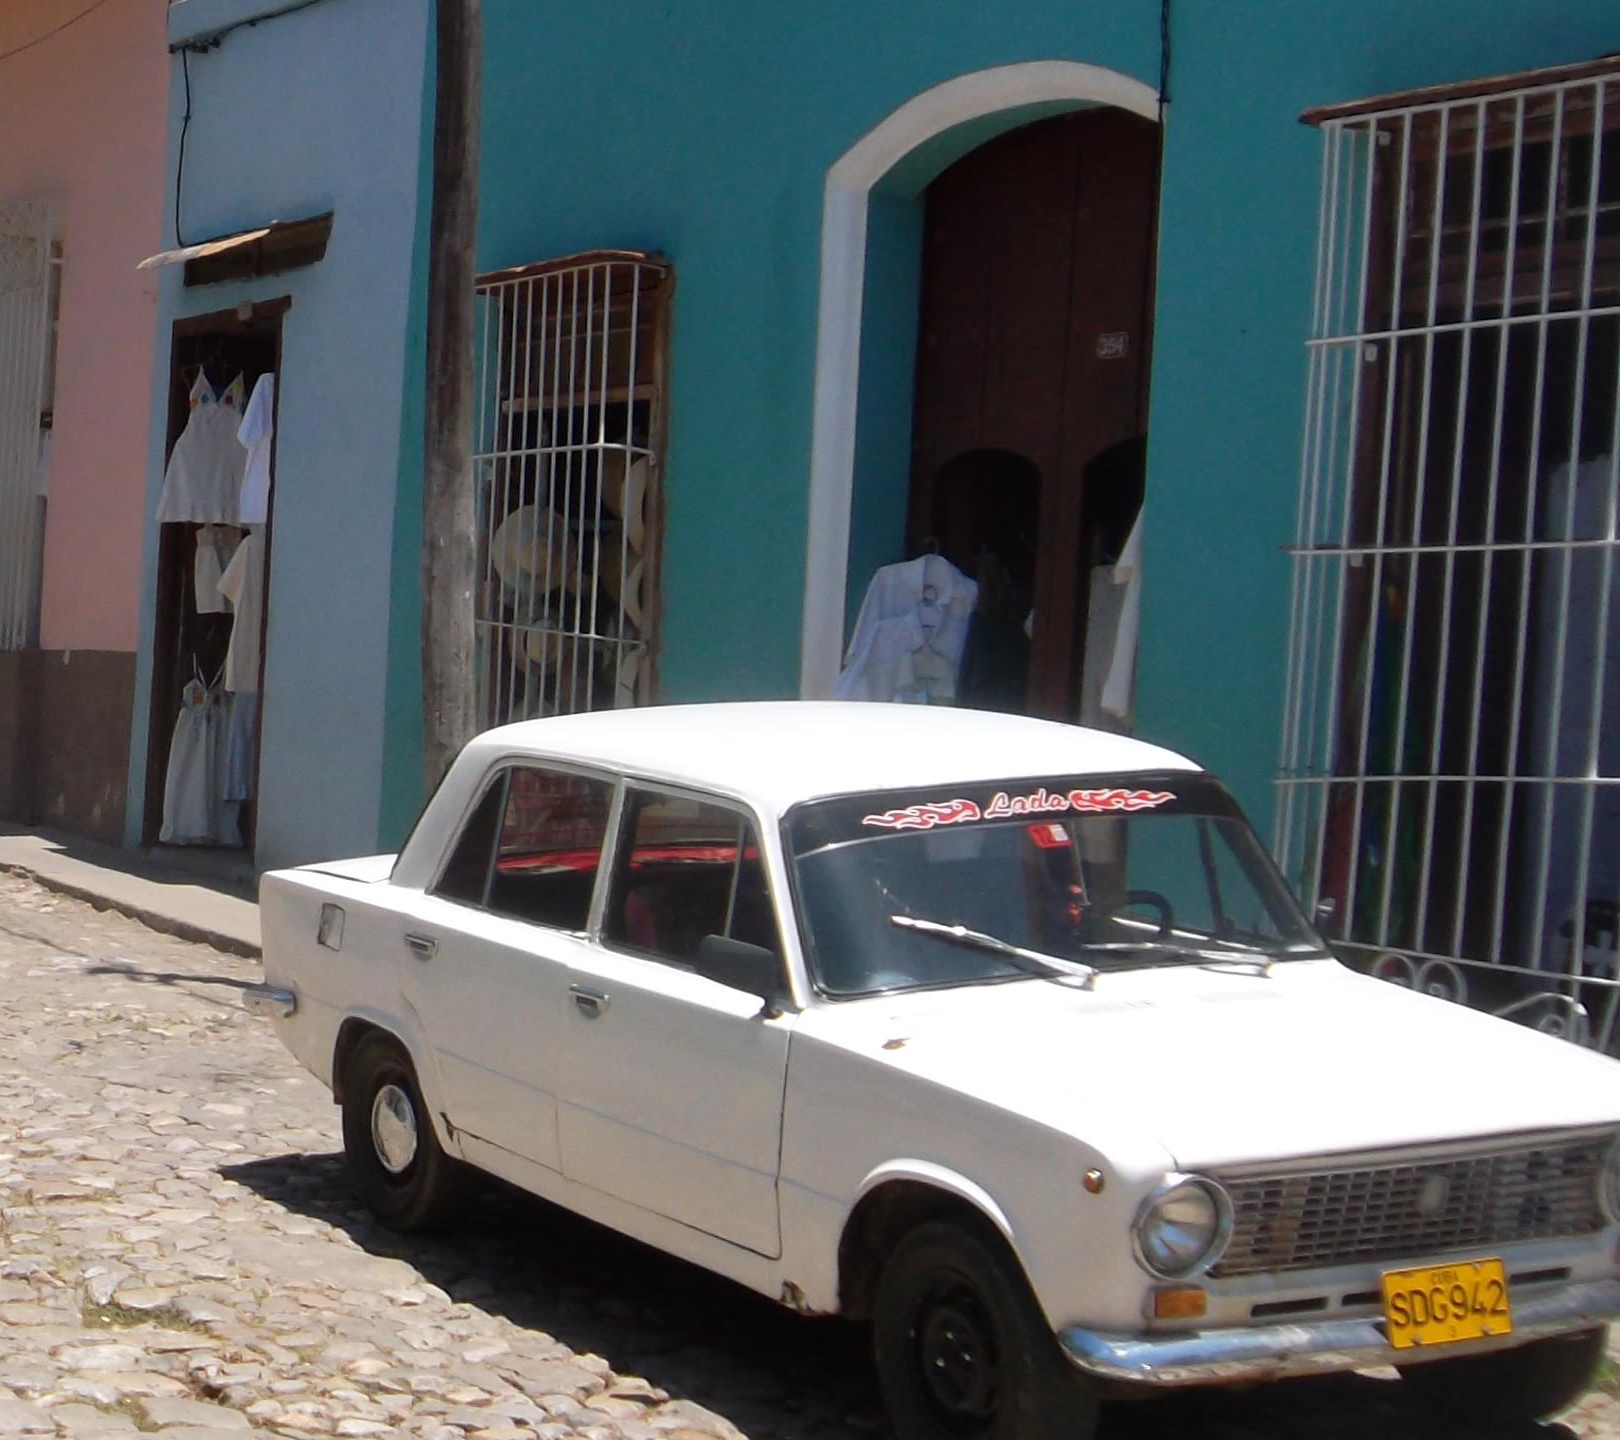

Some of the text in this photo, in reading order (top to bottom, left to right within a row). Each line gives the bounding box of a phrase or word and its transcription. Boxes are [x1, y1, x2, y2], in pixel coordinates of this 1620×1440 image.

[984, 788, 1070, 818] Lada
[1430, 1270, 1460, 1284] CUBA
[1390, 1279, 1508, 1327] SDG942
